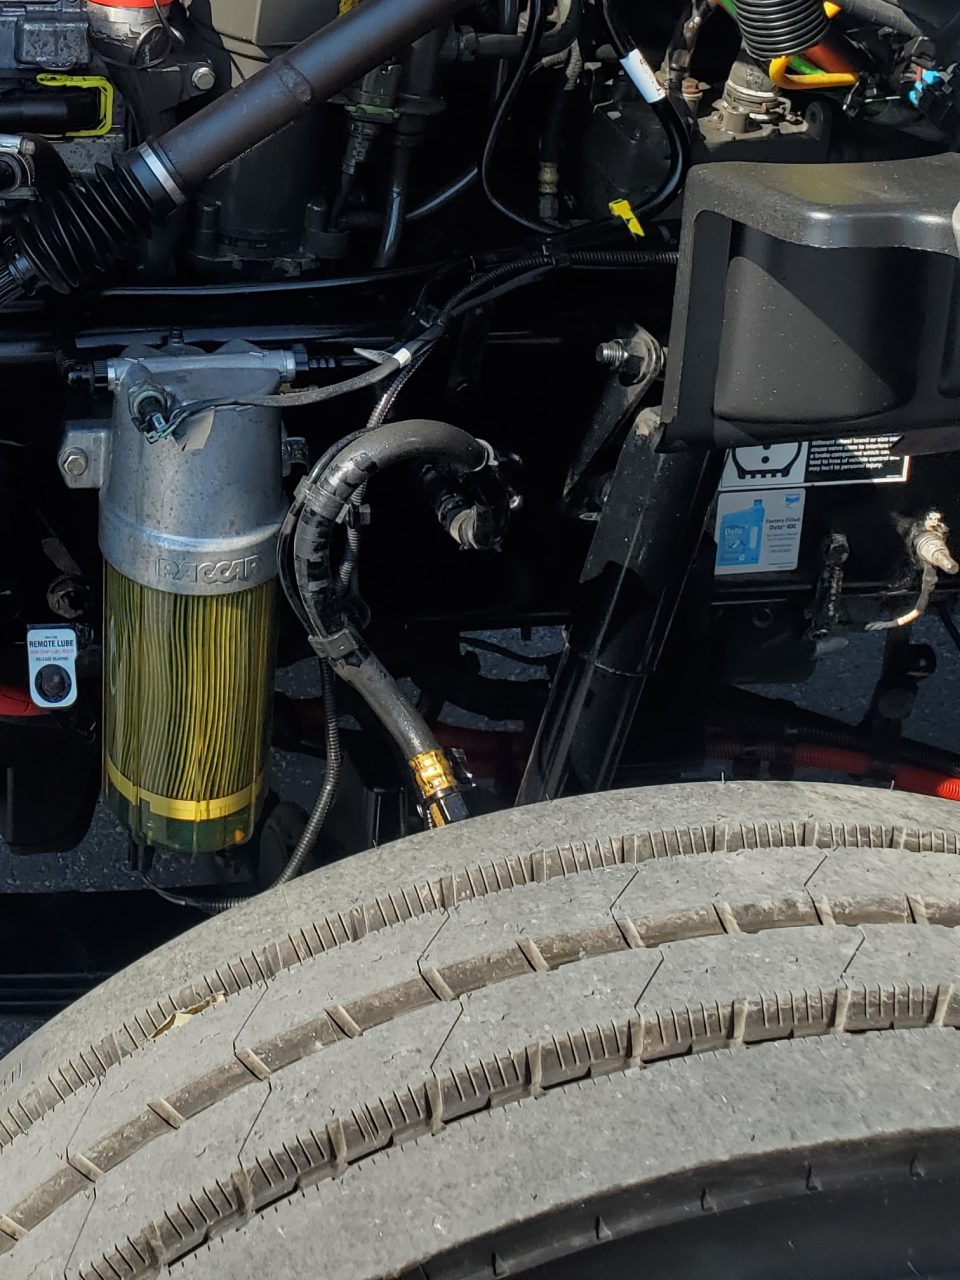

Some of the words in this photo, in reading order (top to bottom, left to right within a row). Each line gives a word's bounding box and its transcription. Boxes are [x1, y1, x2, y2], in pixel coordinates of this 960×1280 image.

[156, 554, 260, 585] PACCAR
[29, 640, 56, 648] REMOTE
[57, 639, 74, 647] LUBE
